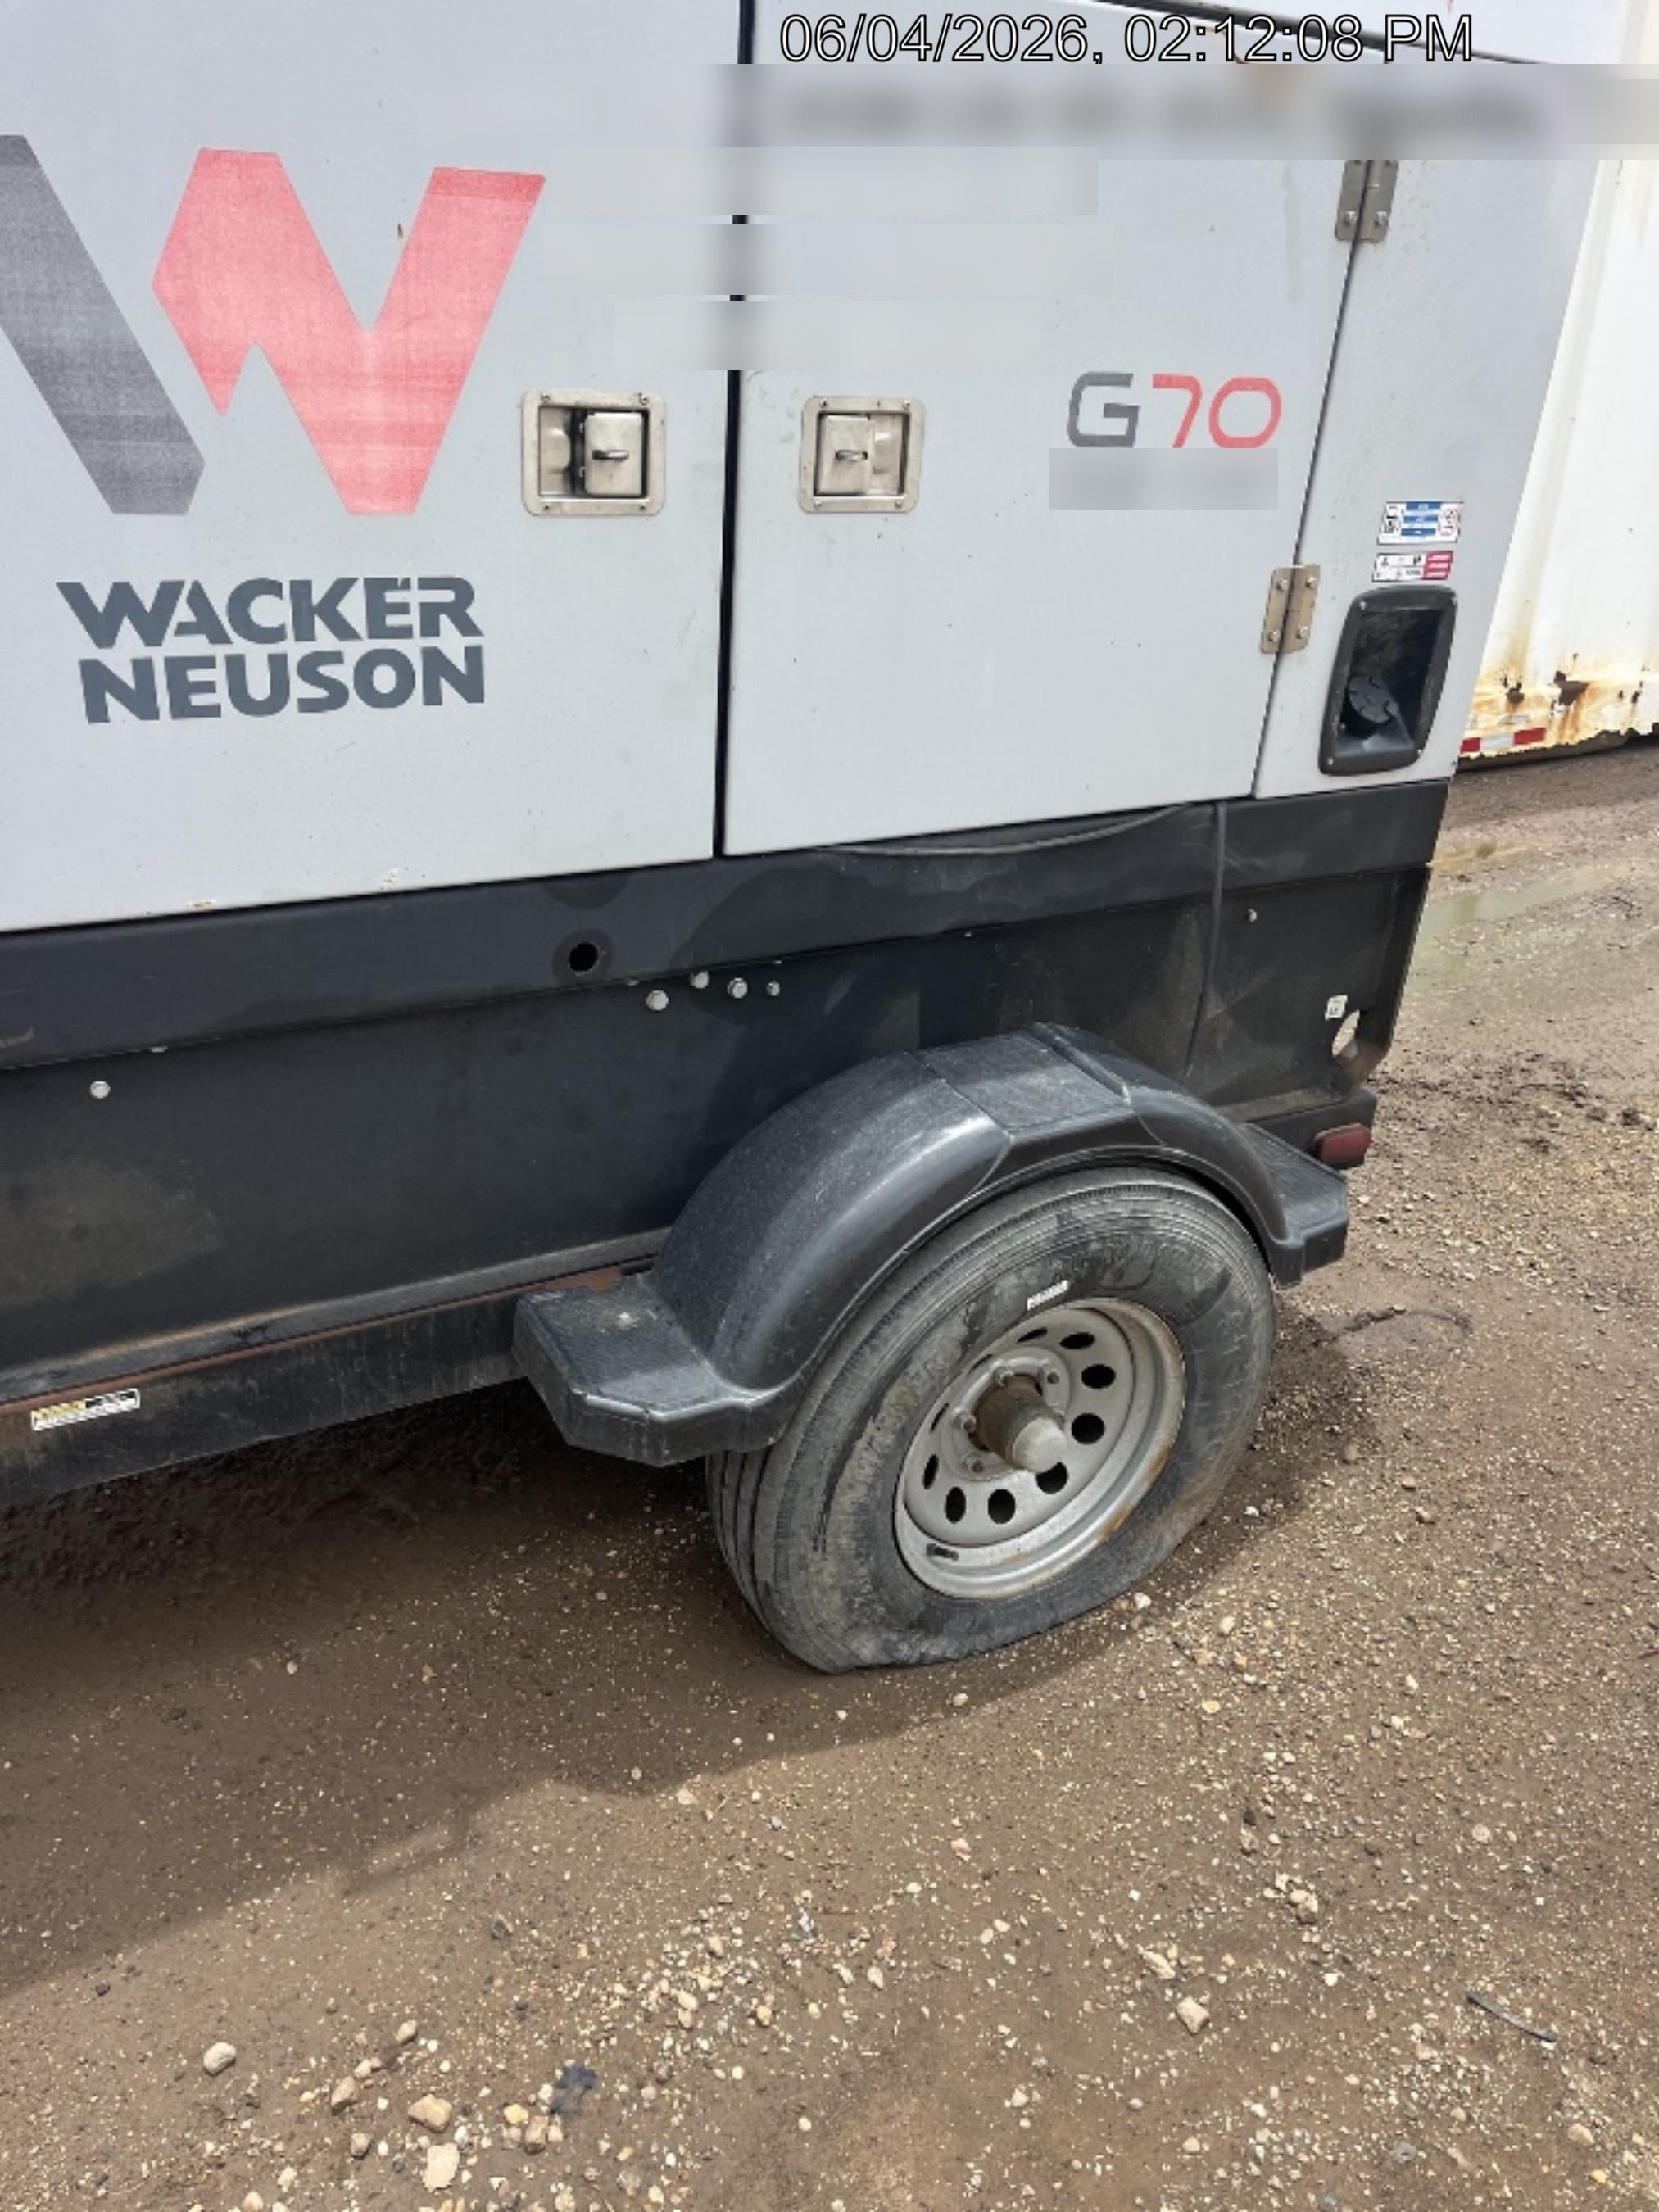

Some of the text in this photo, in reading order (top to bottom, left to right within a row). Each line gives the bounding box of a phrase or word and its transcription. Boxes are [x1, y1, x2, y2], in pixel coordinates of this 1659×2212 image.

[1067, 371, 1281, 448] G70
[56, 576, 484, 649] WACKER
[79, 645, 484, 723] NEUSON
